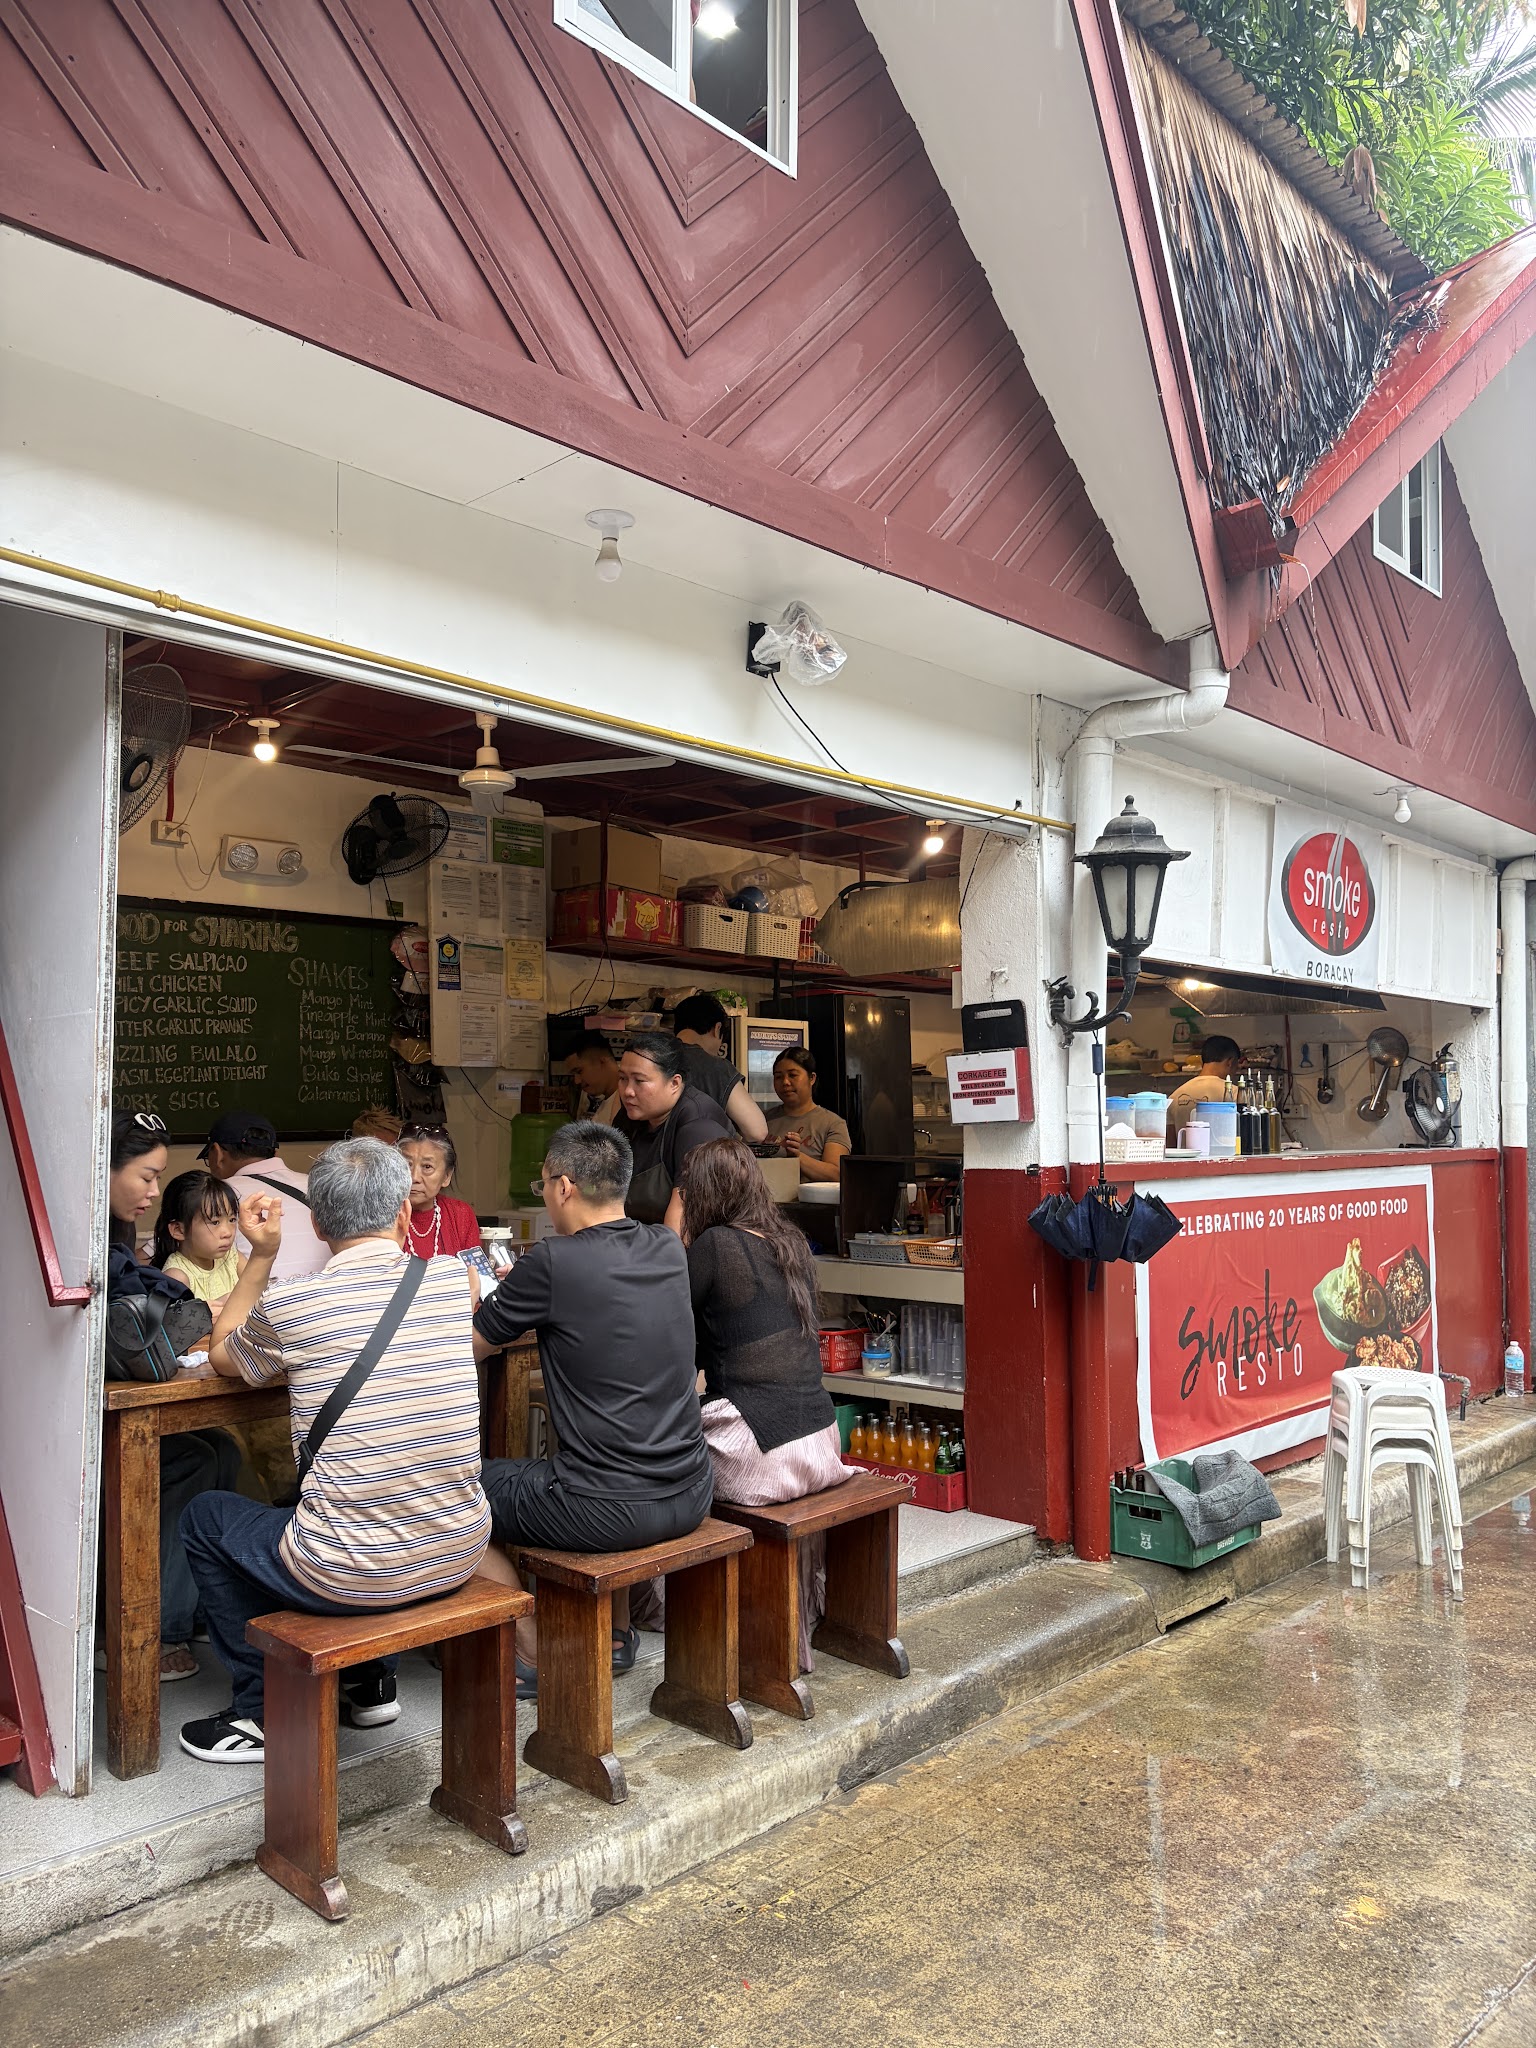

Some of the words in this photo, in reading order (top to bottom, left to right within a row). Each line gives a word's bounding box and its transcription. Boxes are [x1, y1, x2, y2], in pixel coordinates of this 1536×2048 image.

[1303, 865, 1361, 918] smoke
[163, 919, 188, 935] FOR
[189, 915, 299, 953] SHARING
[1312, 917, 1350, 940] resto
[117, 950, 160, 971] EEF
[169, 951, 248, 973] SALPICAO
[1306, 960, 1354, 984] BORACAY
[116, 974, 144, 993] HILI
[149, 974, 222, 993] CHICKEN
[287, 957, 369, 990] SHAKES
[115, 995, 151, 1014] PICY
[153, 995, 213, 1015] GARLIC
[217, 995, 258, 1015] SQUID
[300, 989, 343, 1010] Mango
[350, 993, 374, 1010] Mint
[299, 1005, 359, 1028] Pineapple
[115, 1018, 155, 1038] TTER
[156, 1017, 204, 1036] GARLIC
[205, 1017, 254, 1035] PRAWNS
[299, 1023, 340, 1044] Mango
[346, 1025, 386, 1042] Banana
[115, 1044, 178, 1063] IZZLING
[190, 1044, 257, 1063] BULALO
[299, 1044, 337, 1064] Mango
[155, 1065, 223, 1084] EGGPLANT
[223, 1064, 268, 1081] DELIGHT
[346, 1065, 383, 1084] Shake
[958, 1070, 992, 1080] CORKAGE
[993, 1069, 1007, 1077] FEE
[168, 1090, 220, 1112] SISIG
[297, 1085, 361, 1103] Calamansi
[1178, 1210, 1265, 1237] ELEBRATING
[1269, 1208, 1285, 1228] 20
[1288, 1204, 1326, 1225] YEARS
[1329, 1203, 1344, 1221] OF
[1346, 1200, 1378, 1219] GOOD
[1380, 1197, 1409, 1215] FOOD
[1216, 1342, 1304, 1397] RESTO
